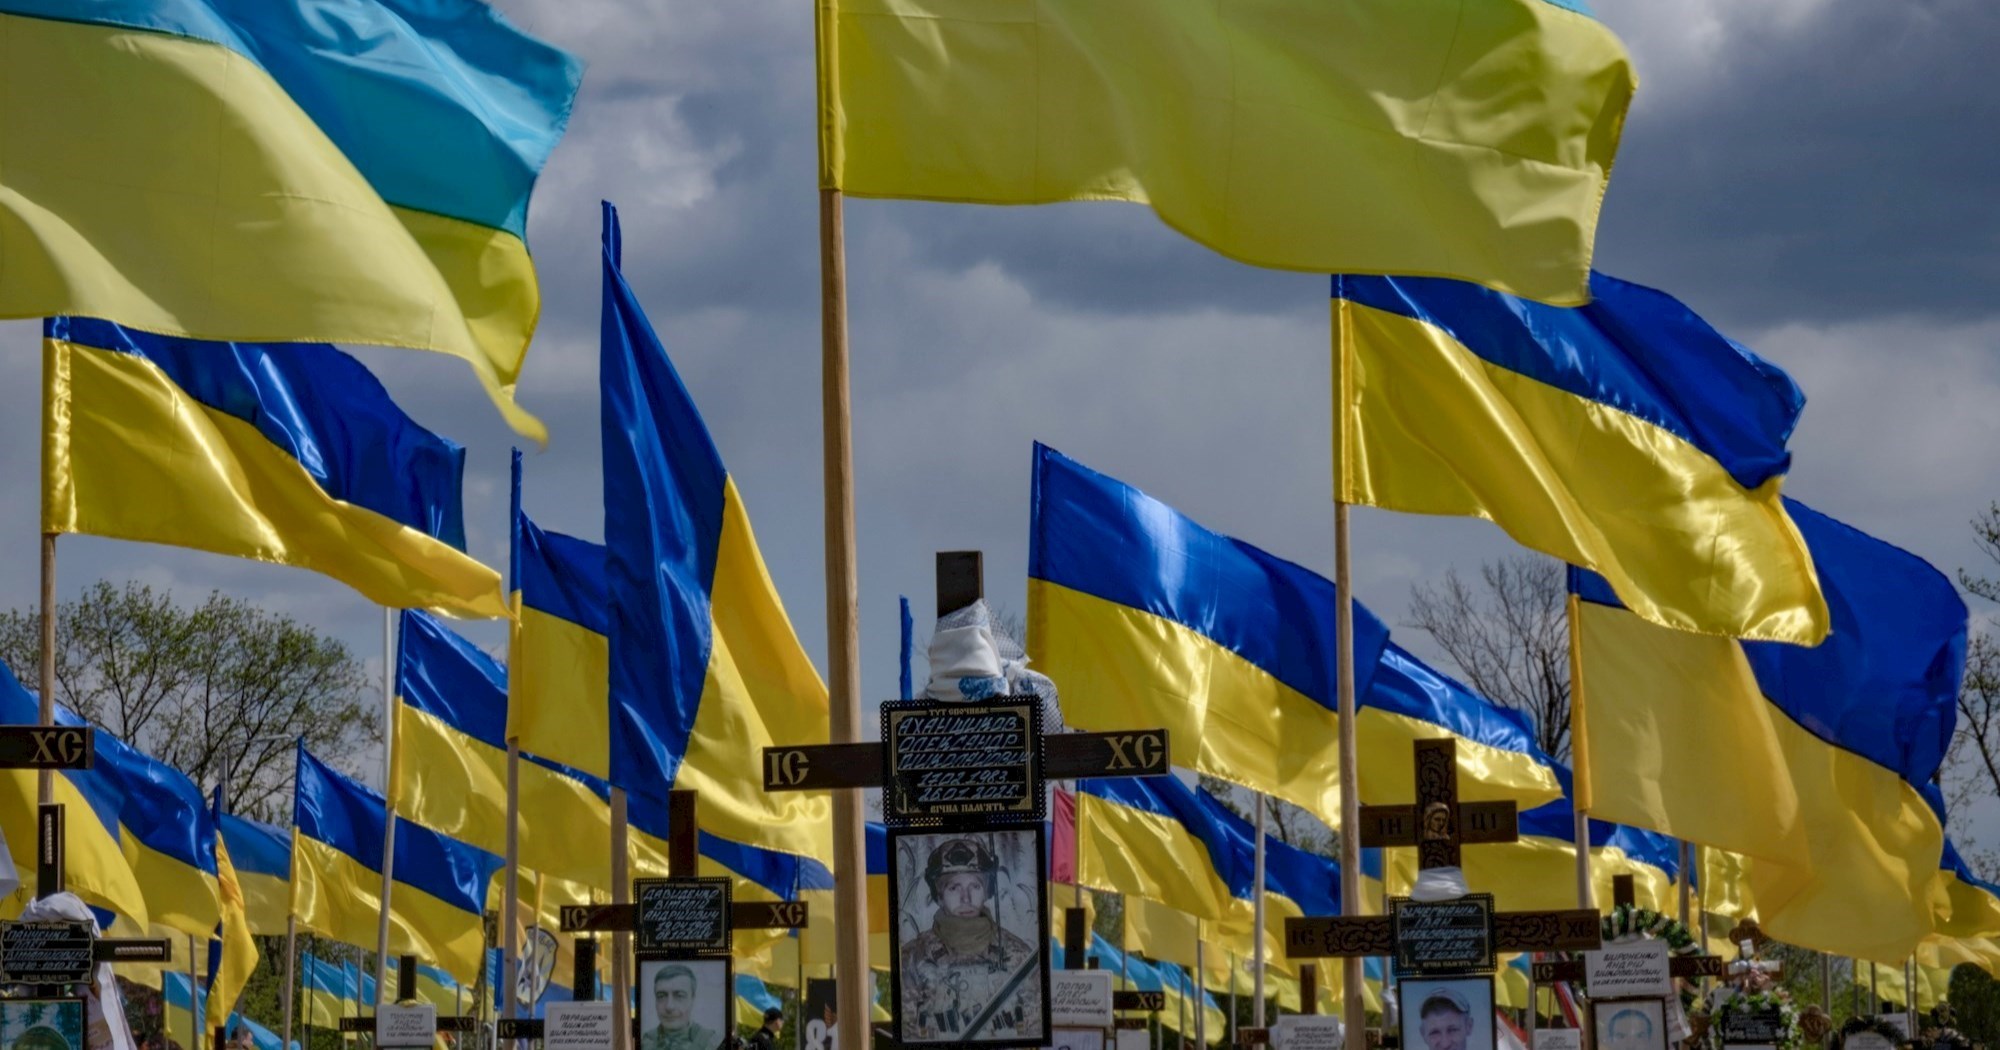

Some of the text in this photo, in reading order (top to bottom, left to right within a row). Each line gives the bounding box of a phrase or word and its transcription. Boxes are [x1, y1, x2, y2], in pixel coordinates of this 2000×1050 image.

[929, 708, 947, 716] ТУТ
[898, 735, 1018, 752] ОЛЕКСАНДР
[930, 803, 1006, 813] ВІЧНА ПАМ'ЯТЬ
